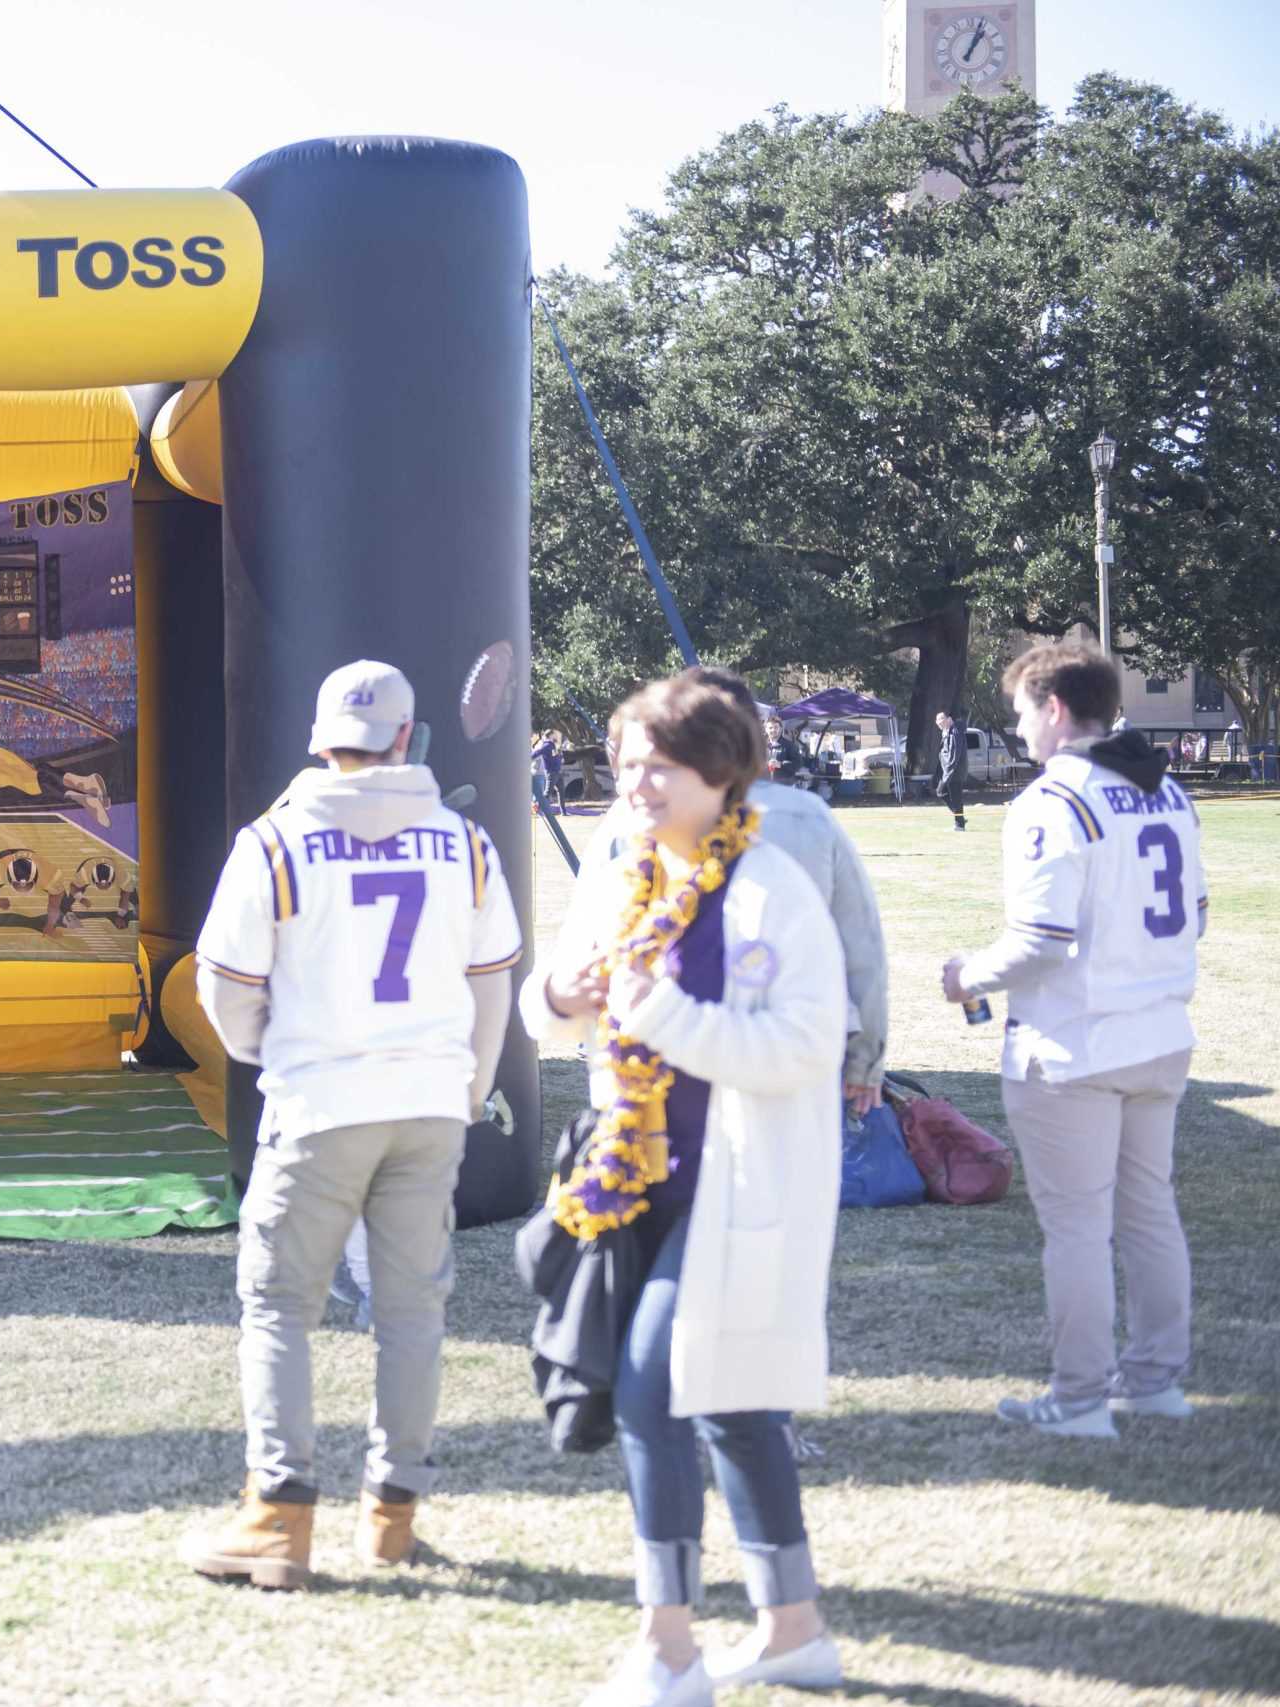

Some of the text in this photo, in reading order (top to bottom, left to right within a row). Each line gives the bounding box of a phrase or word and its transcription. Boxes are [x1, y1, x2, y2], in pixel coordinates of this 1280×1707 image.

[17, 235, 227, 299] TOSS
[10, 490, 110, 530] TOSS
[1023, 825, 1045, 861] 3
[1136, 822, 1187, 939] 3
[351, 870, 427, 1003] 7
